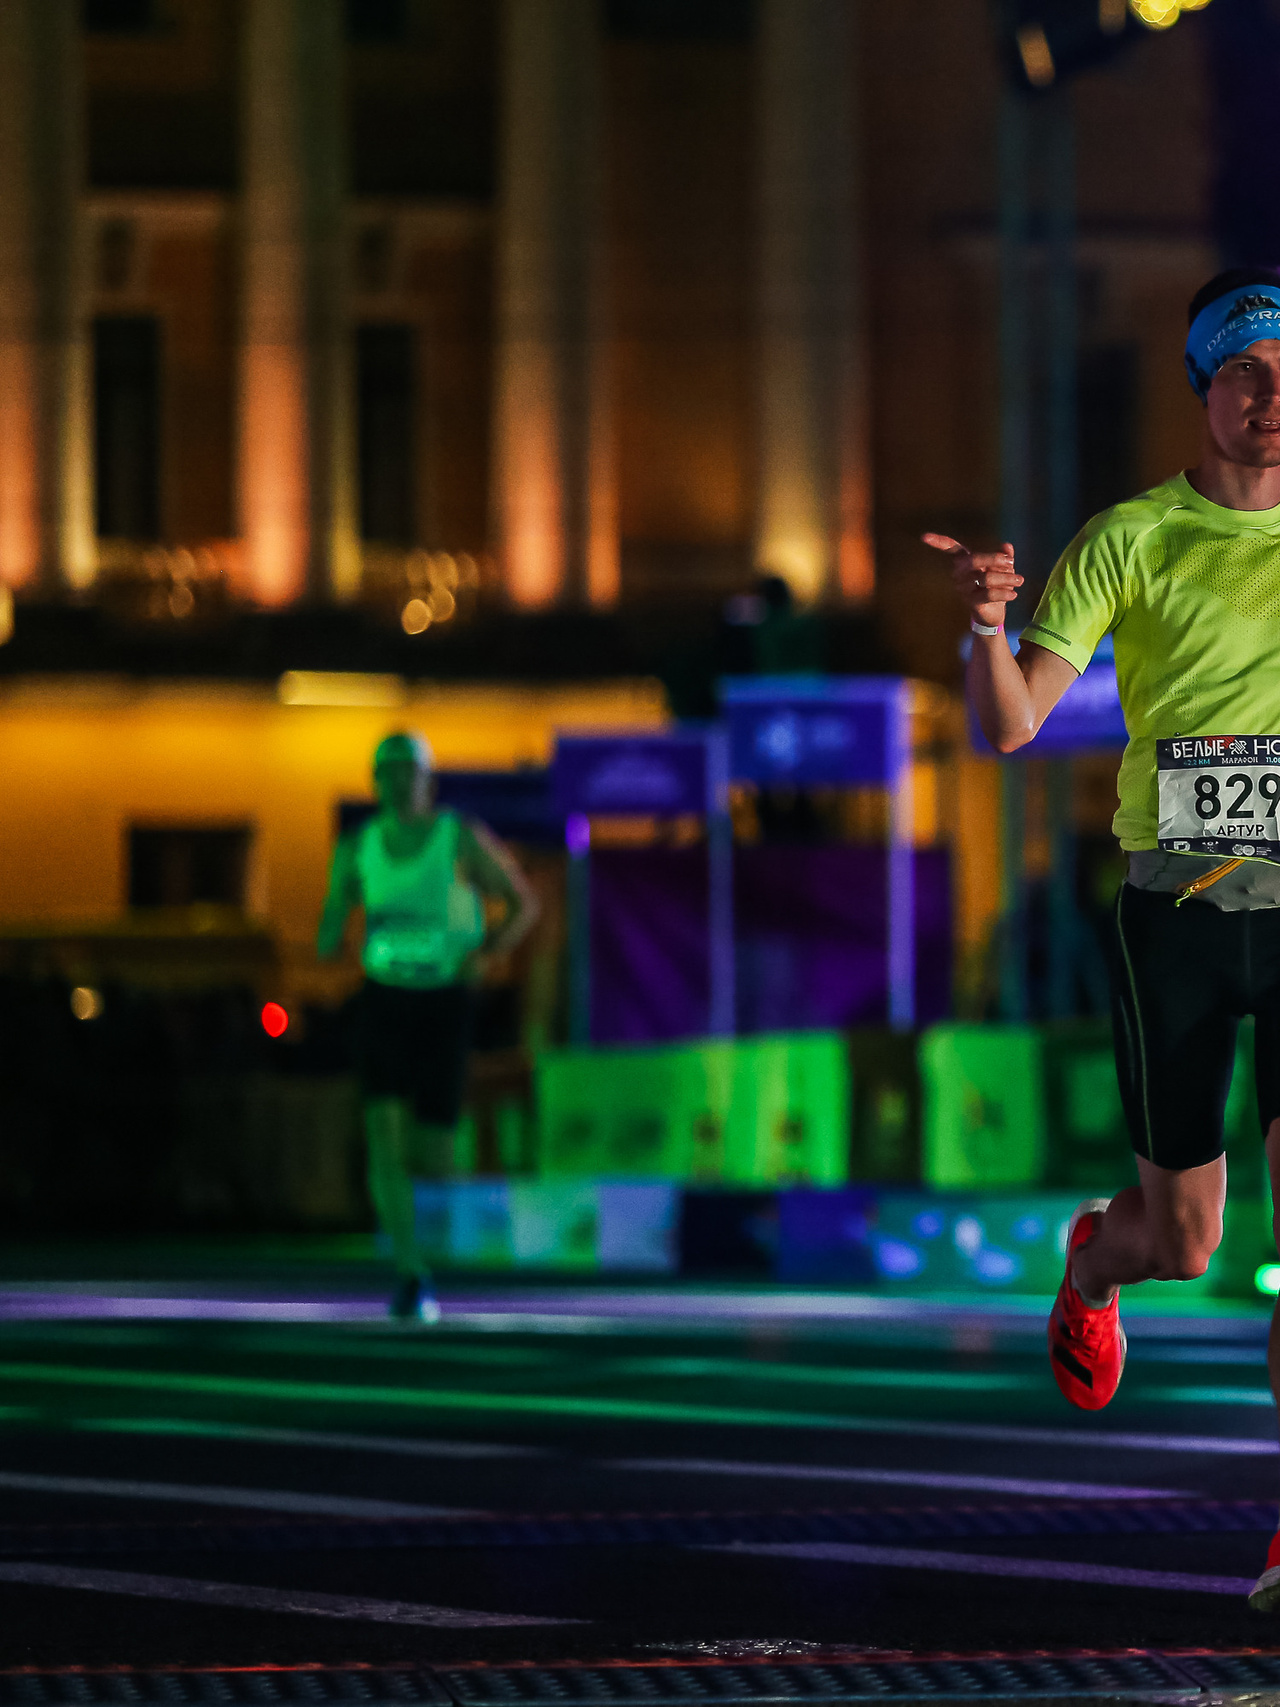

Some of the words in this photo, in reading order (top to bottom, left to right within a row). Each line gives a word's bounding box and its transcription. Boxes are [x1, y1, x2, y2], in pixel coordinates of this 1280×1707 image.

[1172, 739, 1225, 759] БЕЛЫЕ
[1221, 756, 1259, 765] МАРАФОН
[1216, 824, 1265, 837] АРТУР
